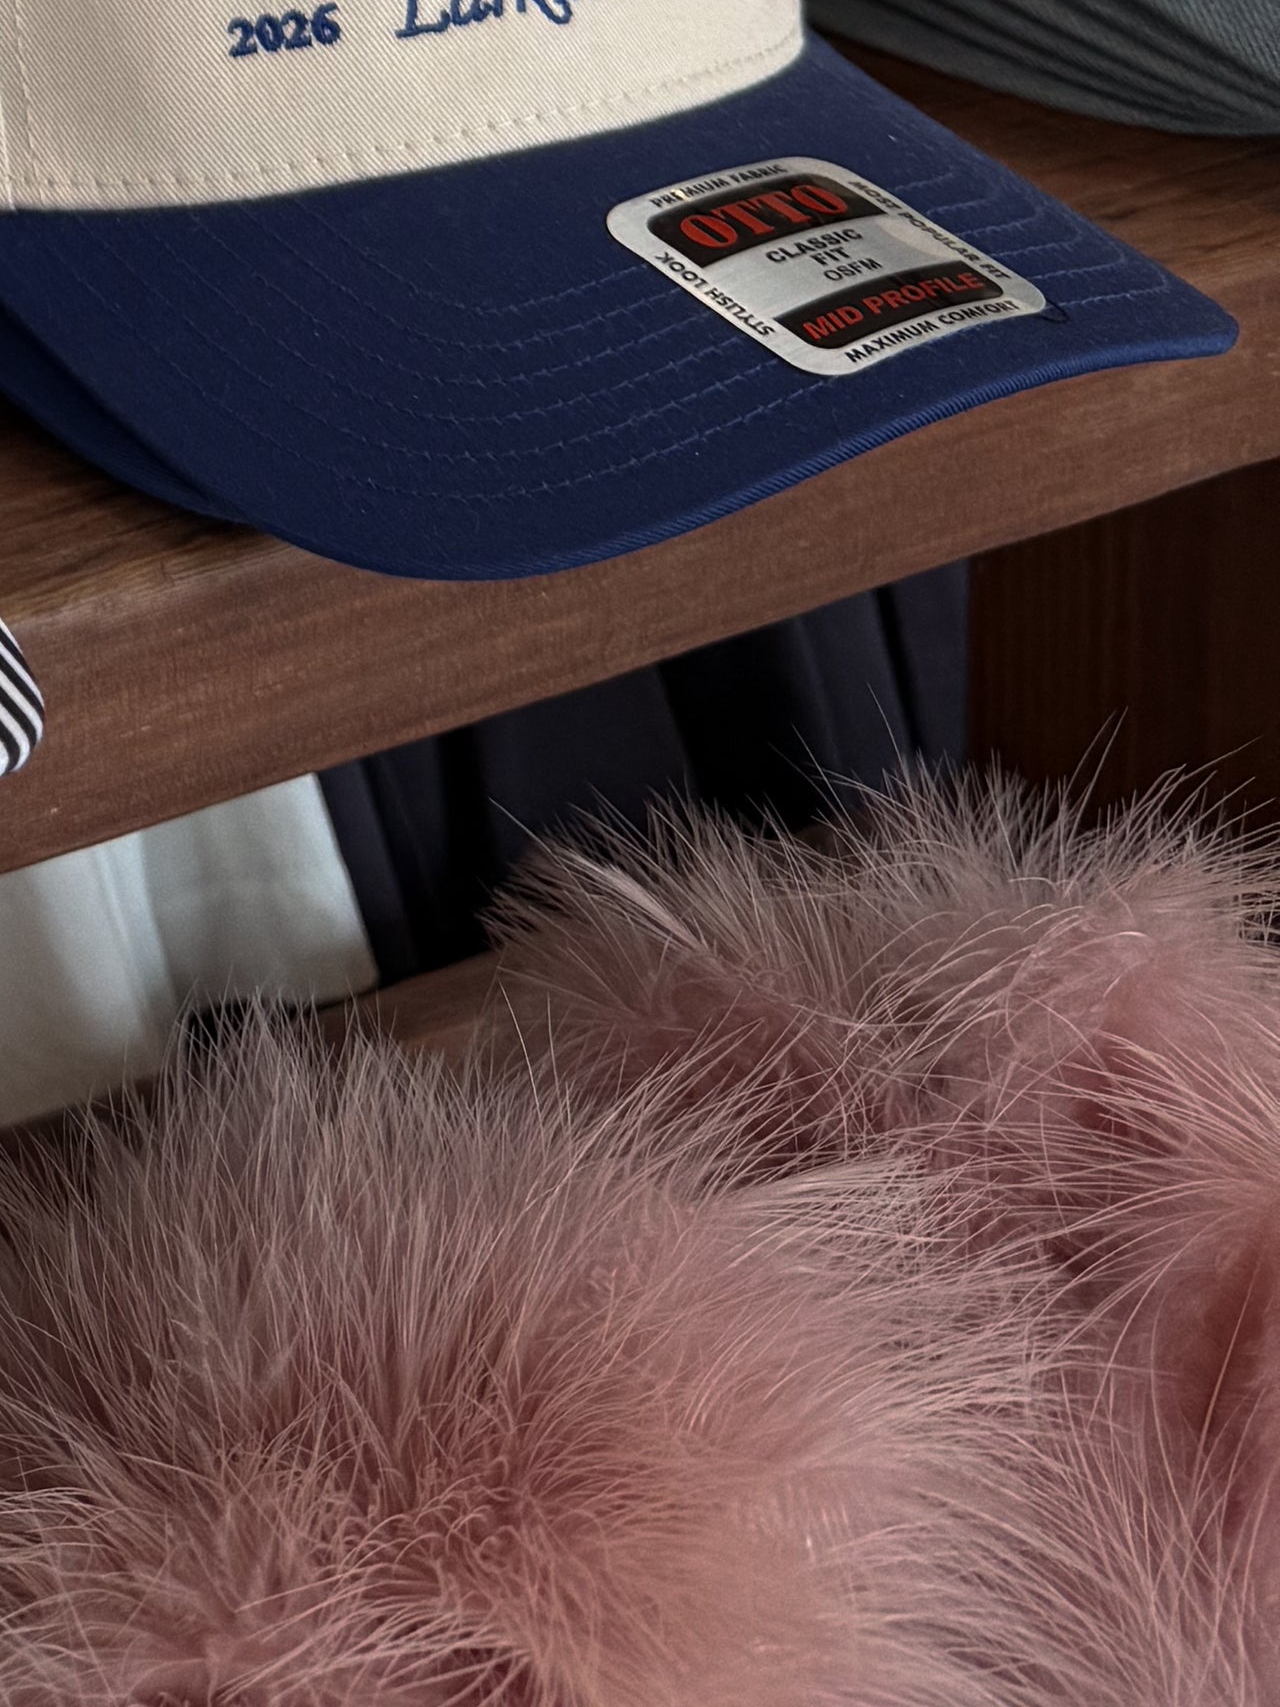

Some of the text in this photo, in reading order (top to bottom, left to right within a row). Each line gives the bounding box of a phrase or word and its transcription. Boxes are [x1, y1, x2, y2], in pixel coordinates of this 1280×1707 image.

[227, 2, 342, 58] 2026
[649, 163, 788, 209] PREMIUM FABRIC
[679, 183, 849, 249] OTTO
[765, 228, 863, 263] CLASSIC
[810, 246, 851, 266] FIT
[848, 180, 1012, 281] MOST POPULAR FIT
[654, 251, 777, 337] STYLISH LOOK
[823, 257, 884, 282] OSFM
[802, 271, 986, 342] MID PROFILE
[844, 299, 1022, 364] MAXIMUM COMFORT
